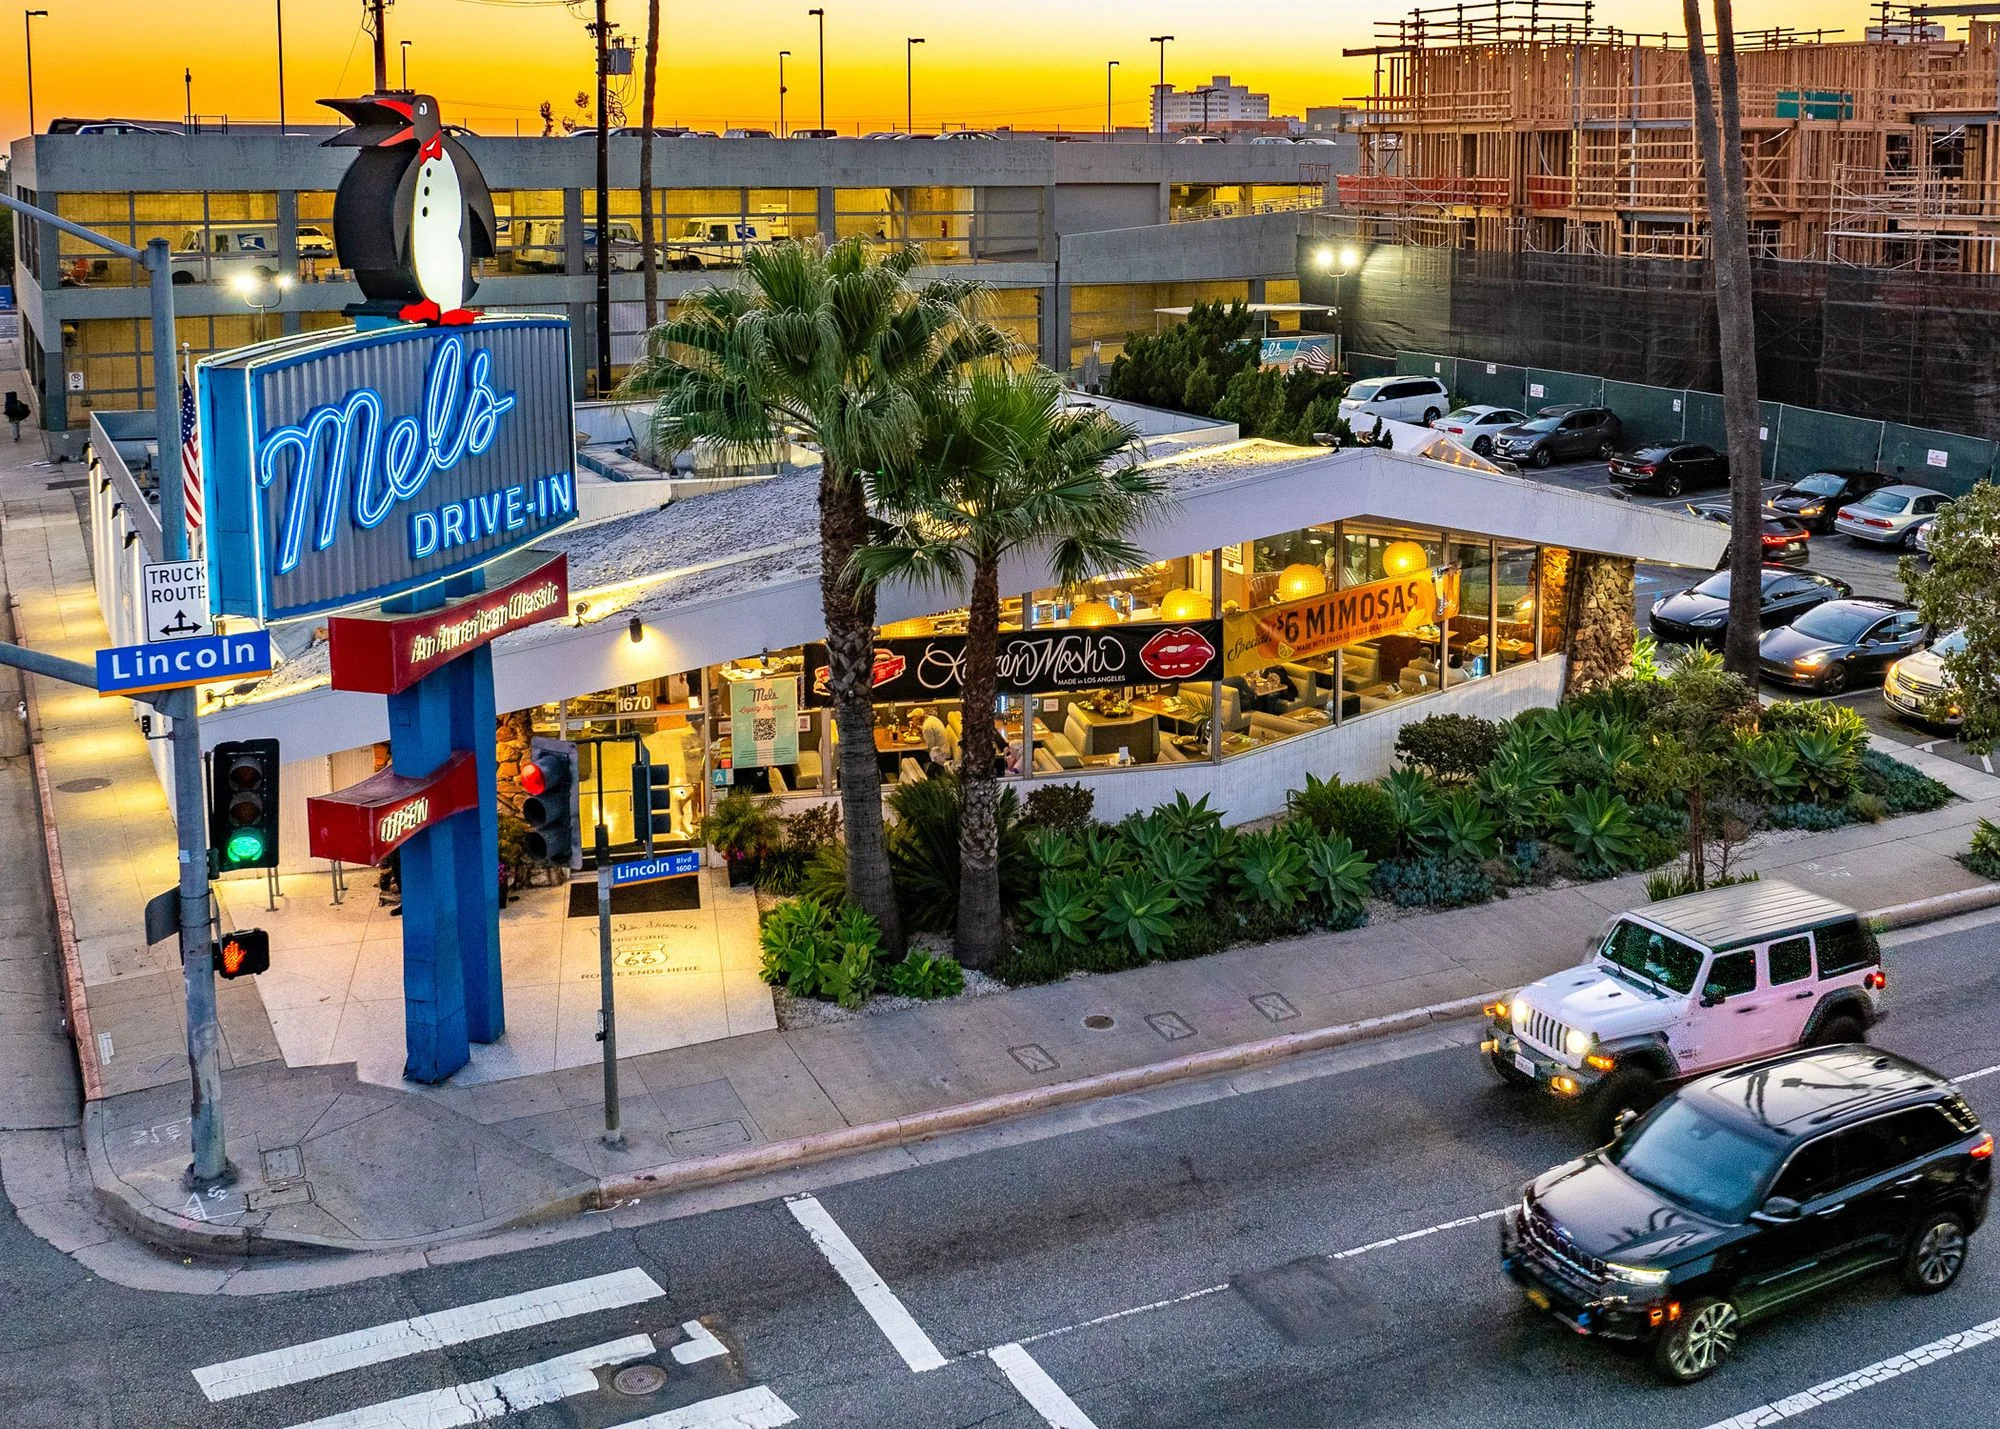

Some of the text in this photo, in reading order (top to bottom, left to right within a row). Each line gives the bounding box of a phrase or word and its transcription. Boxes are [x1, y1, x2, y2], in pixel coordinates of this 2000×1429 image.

[257, 333, 516, 576] Mels
[408, 471, 572, 560] DRIVE-IN
[149, 566, 206, 585] TRUCK
[151, 585, 207, 604] ROUTE
[1276, 581, 1419, 644] $6 MIMOSAS
[410, 581, 560, 664] An American Classic
[111, 638, 256, 681] Lincoln
[1058, 677, 1077, 686] MADE
[1083, 676, 1096, 684] LOS
[1096, 674, 1126, 683] ANGELES
[619, 695, 651, 712] 1670
[748, 687, 779, 703] Mels
[714, 772, 725, 784] A
[380, 796, 429, 842] OPEN
[617, 855, 692, 880] Lincoln Blvd
[676, 865, 692, 874] 1600
[667, 964, 701, 972] HERE
